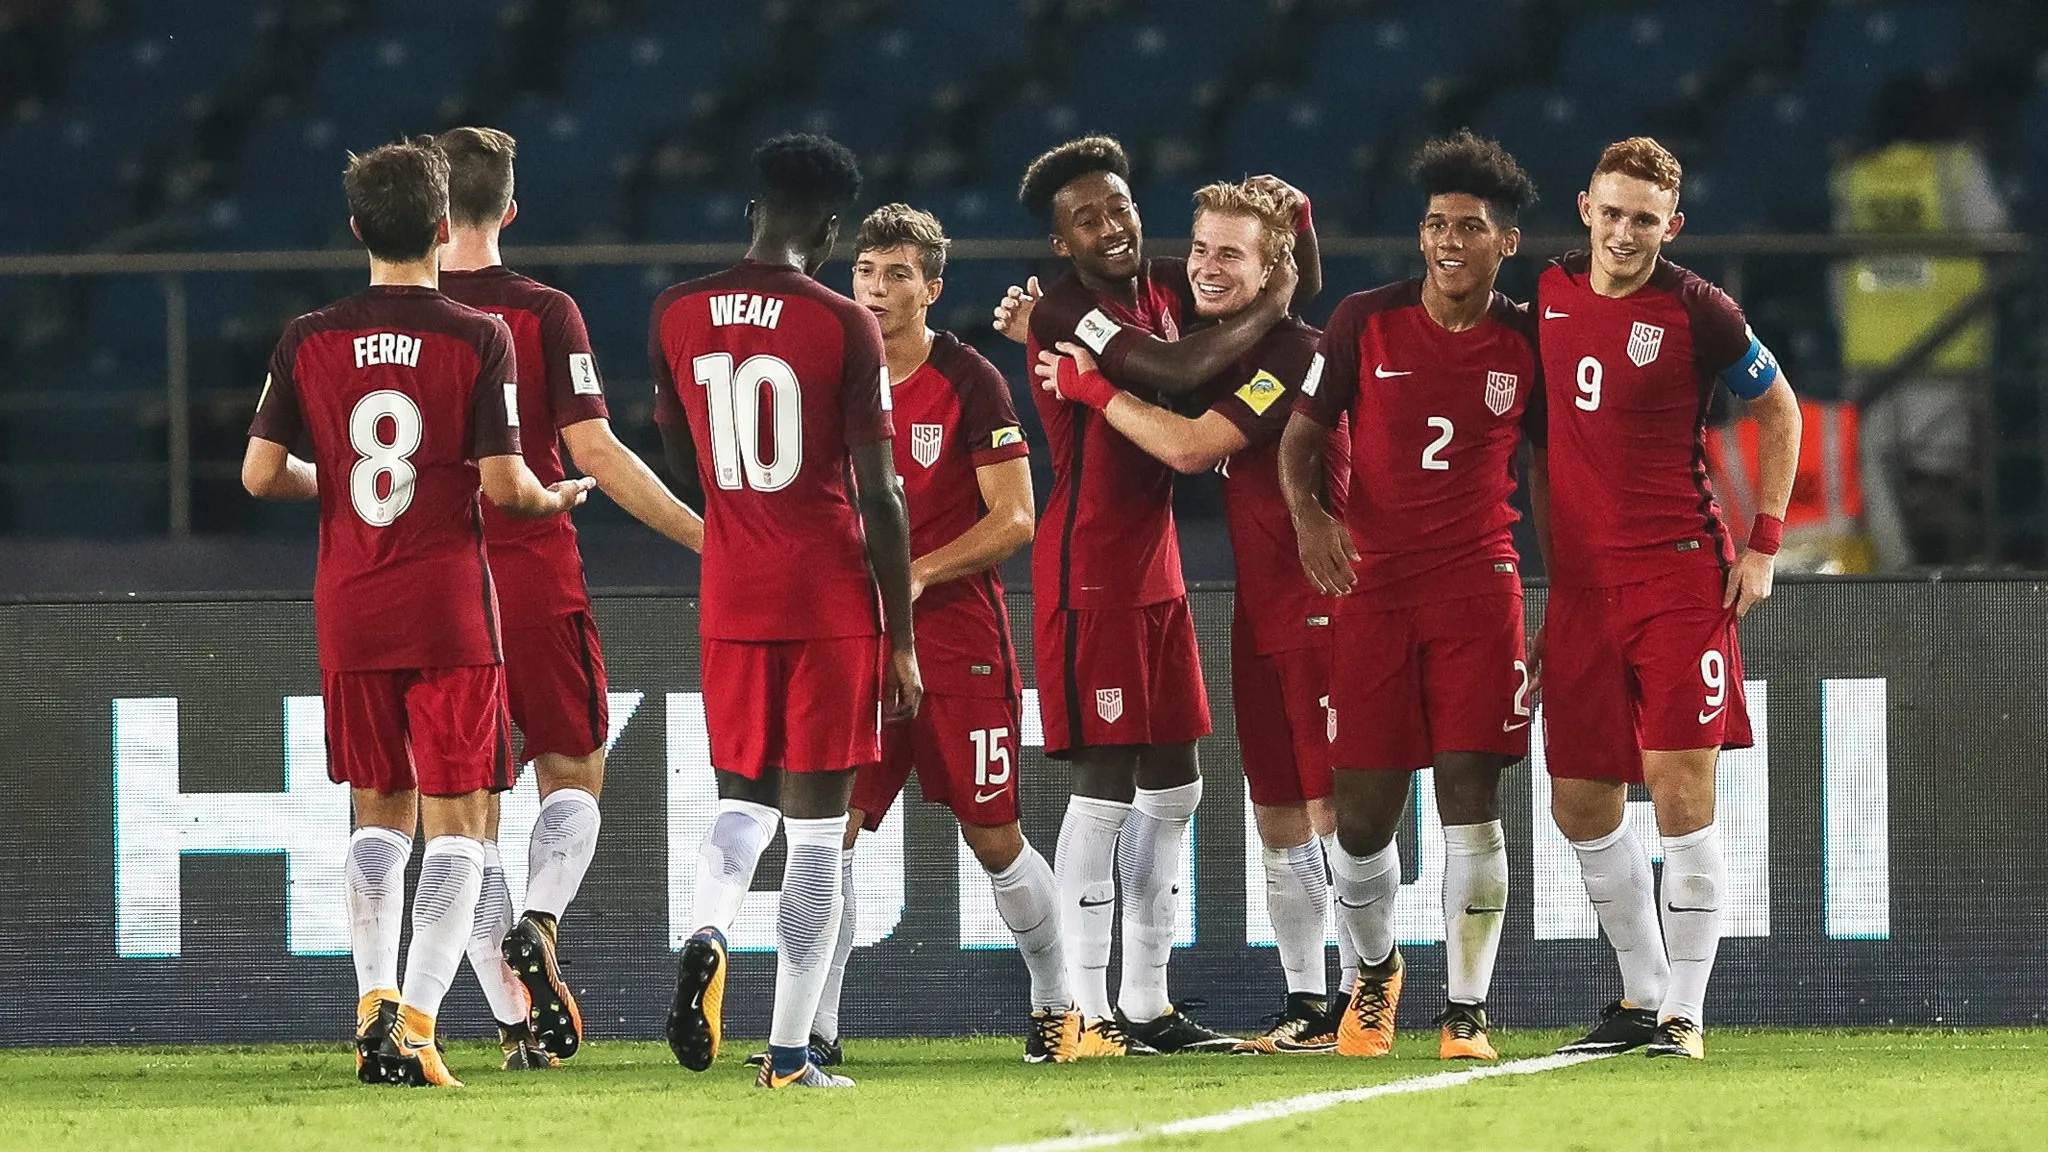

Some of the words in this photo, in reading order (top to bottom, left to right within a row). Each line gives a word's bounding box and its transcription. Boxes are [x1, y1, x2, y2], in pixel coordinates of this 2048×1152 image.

[709, 294, 783, 329] WEAH
[1634, 324, 1661, 342] USA
[353, 333, 422, 368] FERRI
[1488, 372, 1516, 391] USA
[1575, 355, 1603, 411] 9
[693, 352, 803, 492] 10
[914, 426, 940, 442] USA
[1422, 416, 1454, 470] 2
[350, 389, 422, 527] 8
[1098, 690, 1120, 703] USA
[1514, 660, 1530, 716] 2
[1700, 650, 1725, 706] 9
[970, 727, 1010, 785] 15
[111, 677, 1890, 958] HUAI
